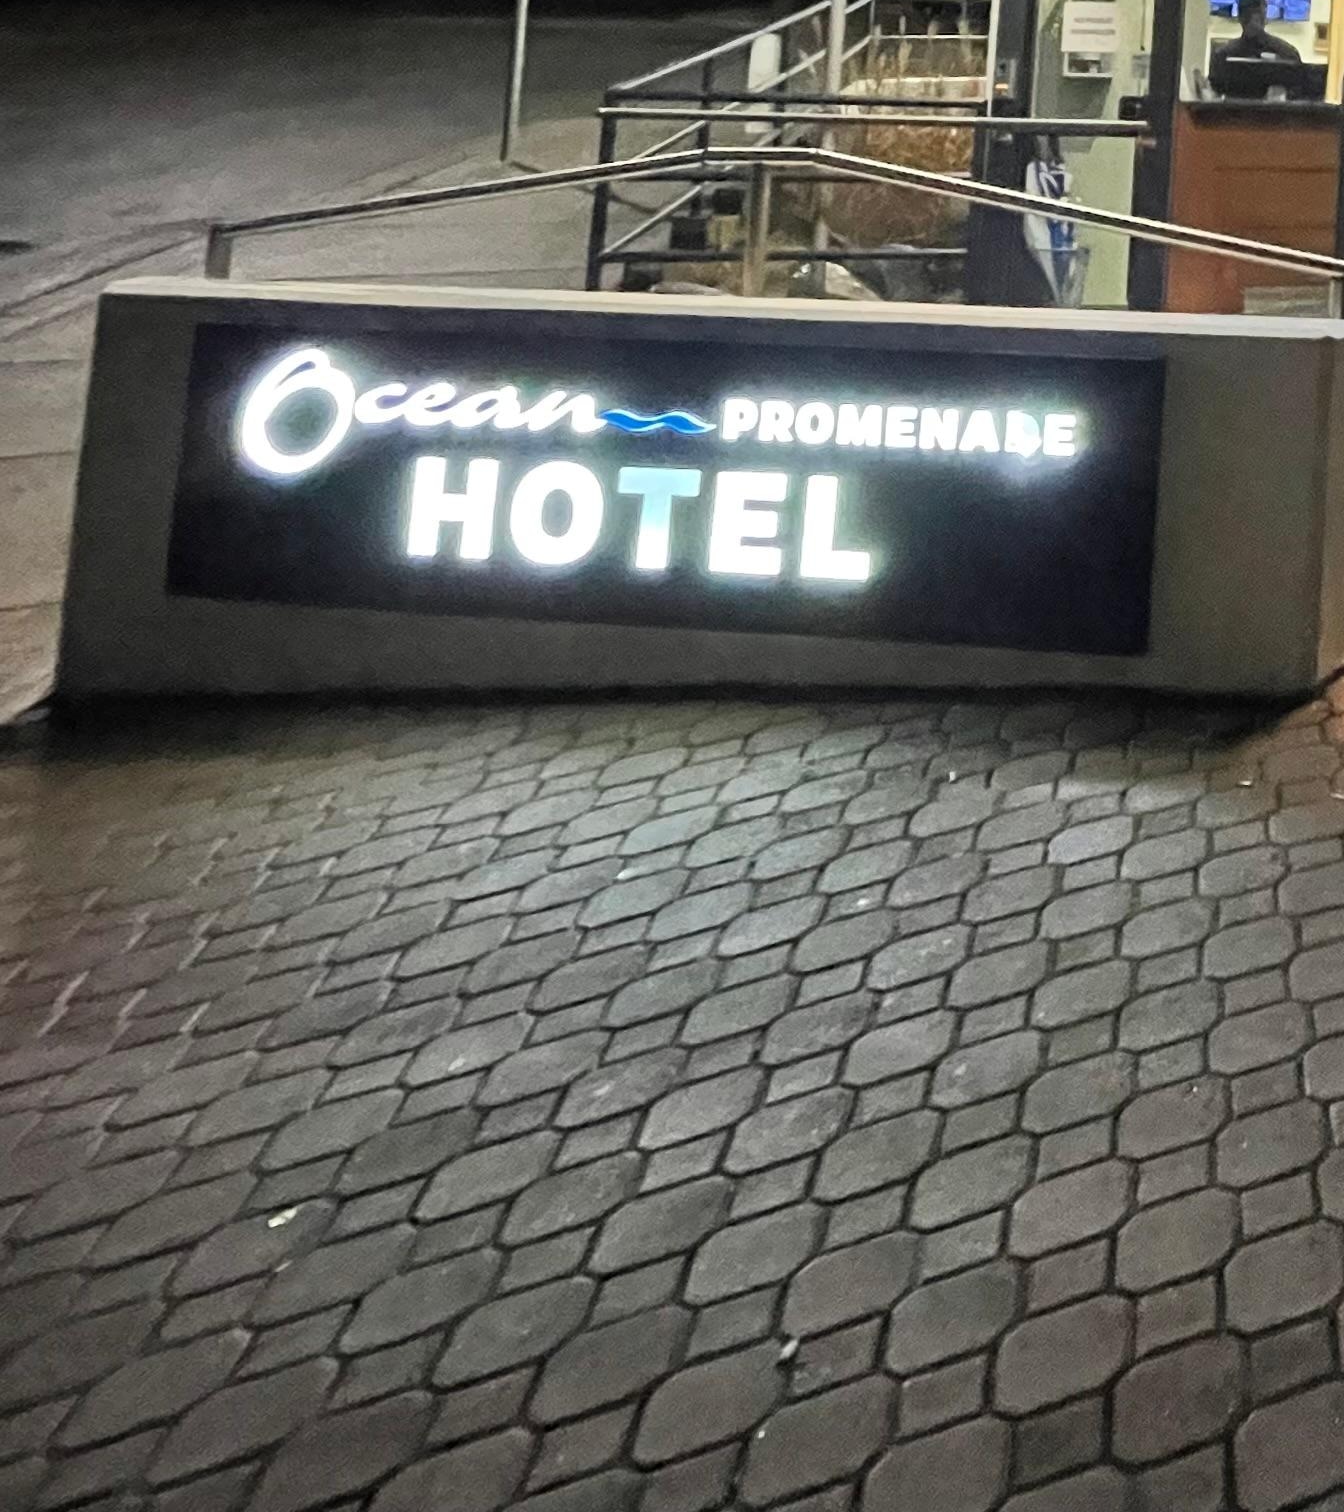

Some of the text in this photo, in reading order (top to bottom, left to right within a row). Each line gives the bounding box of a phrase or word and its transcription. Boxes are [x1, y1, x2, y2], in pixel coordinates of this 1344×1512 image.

[238, 343, 1077, 476] Ocean PROMENADE
[408, 457, 872, 584] HOTEL
